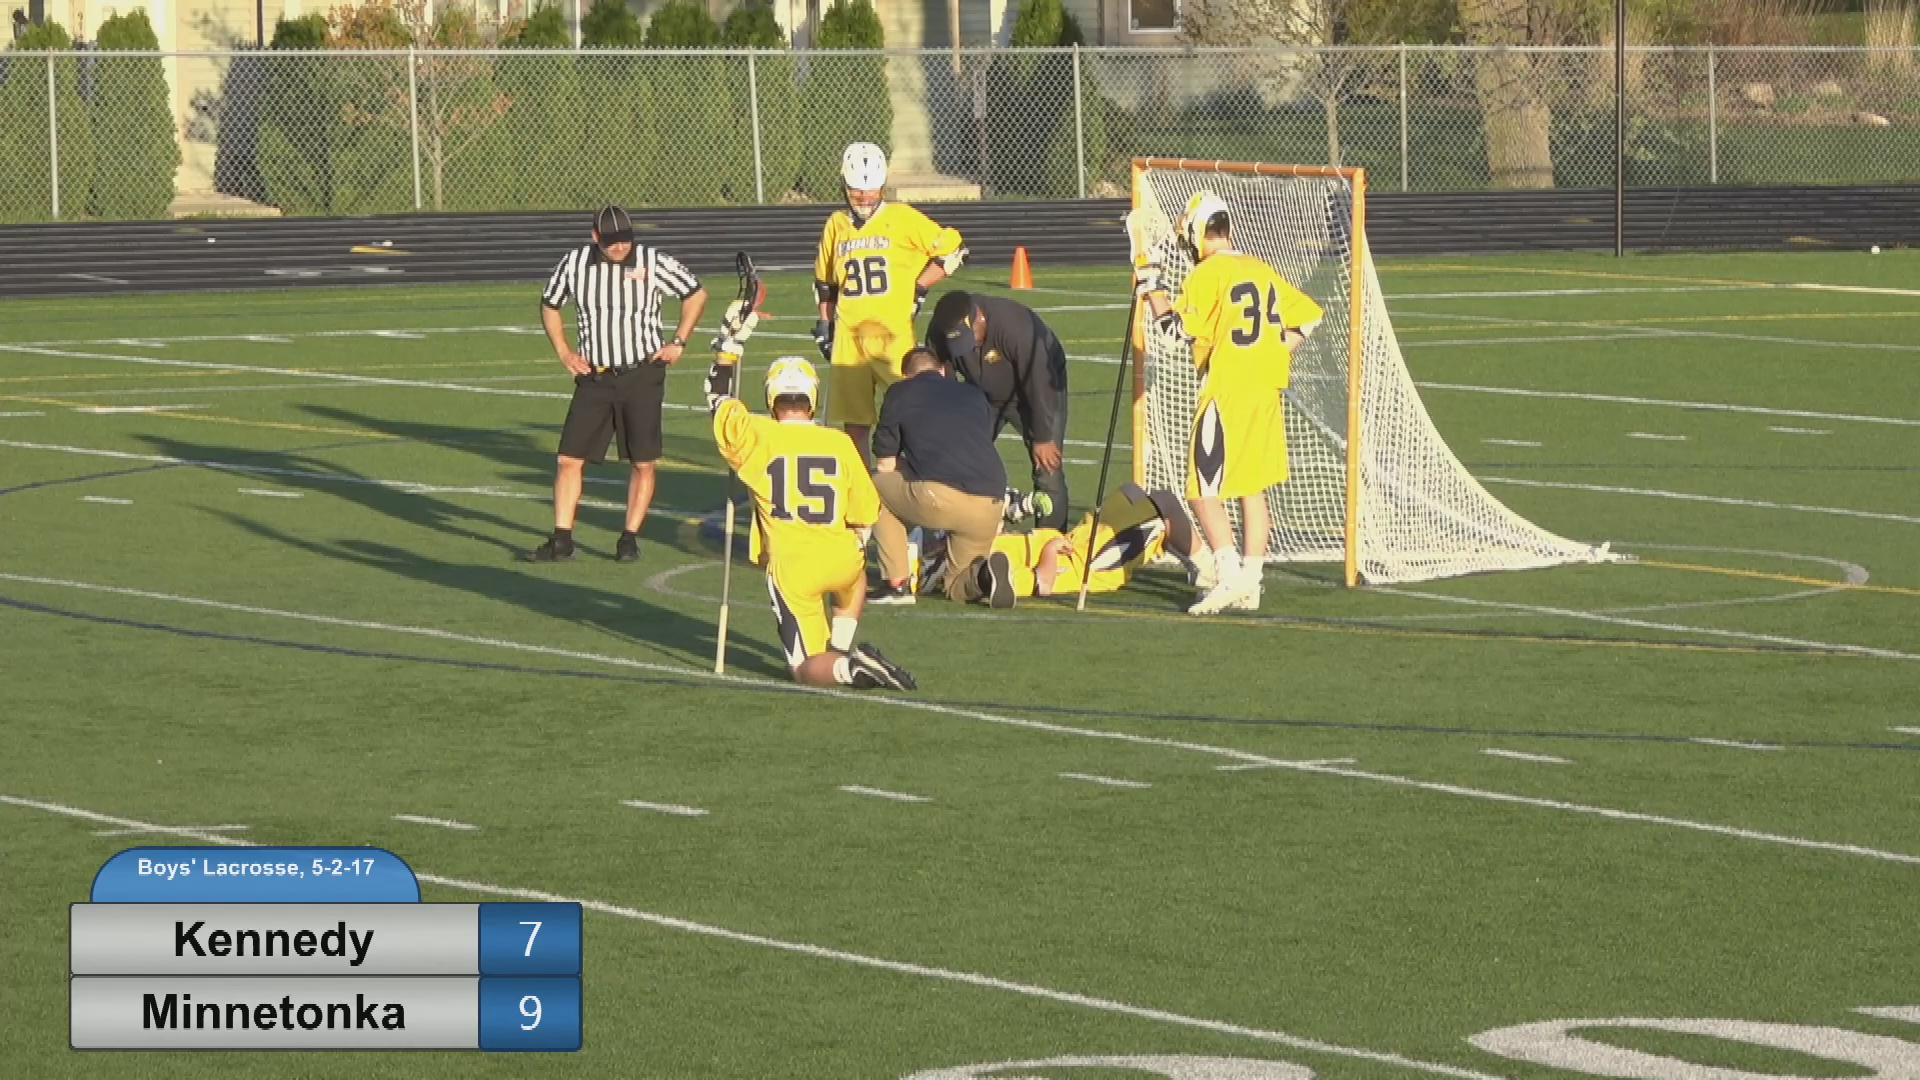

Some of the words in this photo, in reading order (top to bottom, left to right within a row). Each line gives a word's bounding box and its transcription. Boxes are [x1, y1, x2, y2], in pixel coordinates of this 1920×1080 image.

[841, 256, 888, 297] 36
[1229, 281, 1287, 346] 34
[766, 457, 837, 525] 15
